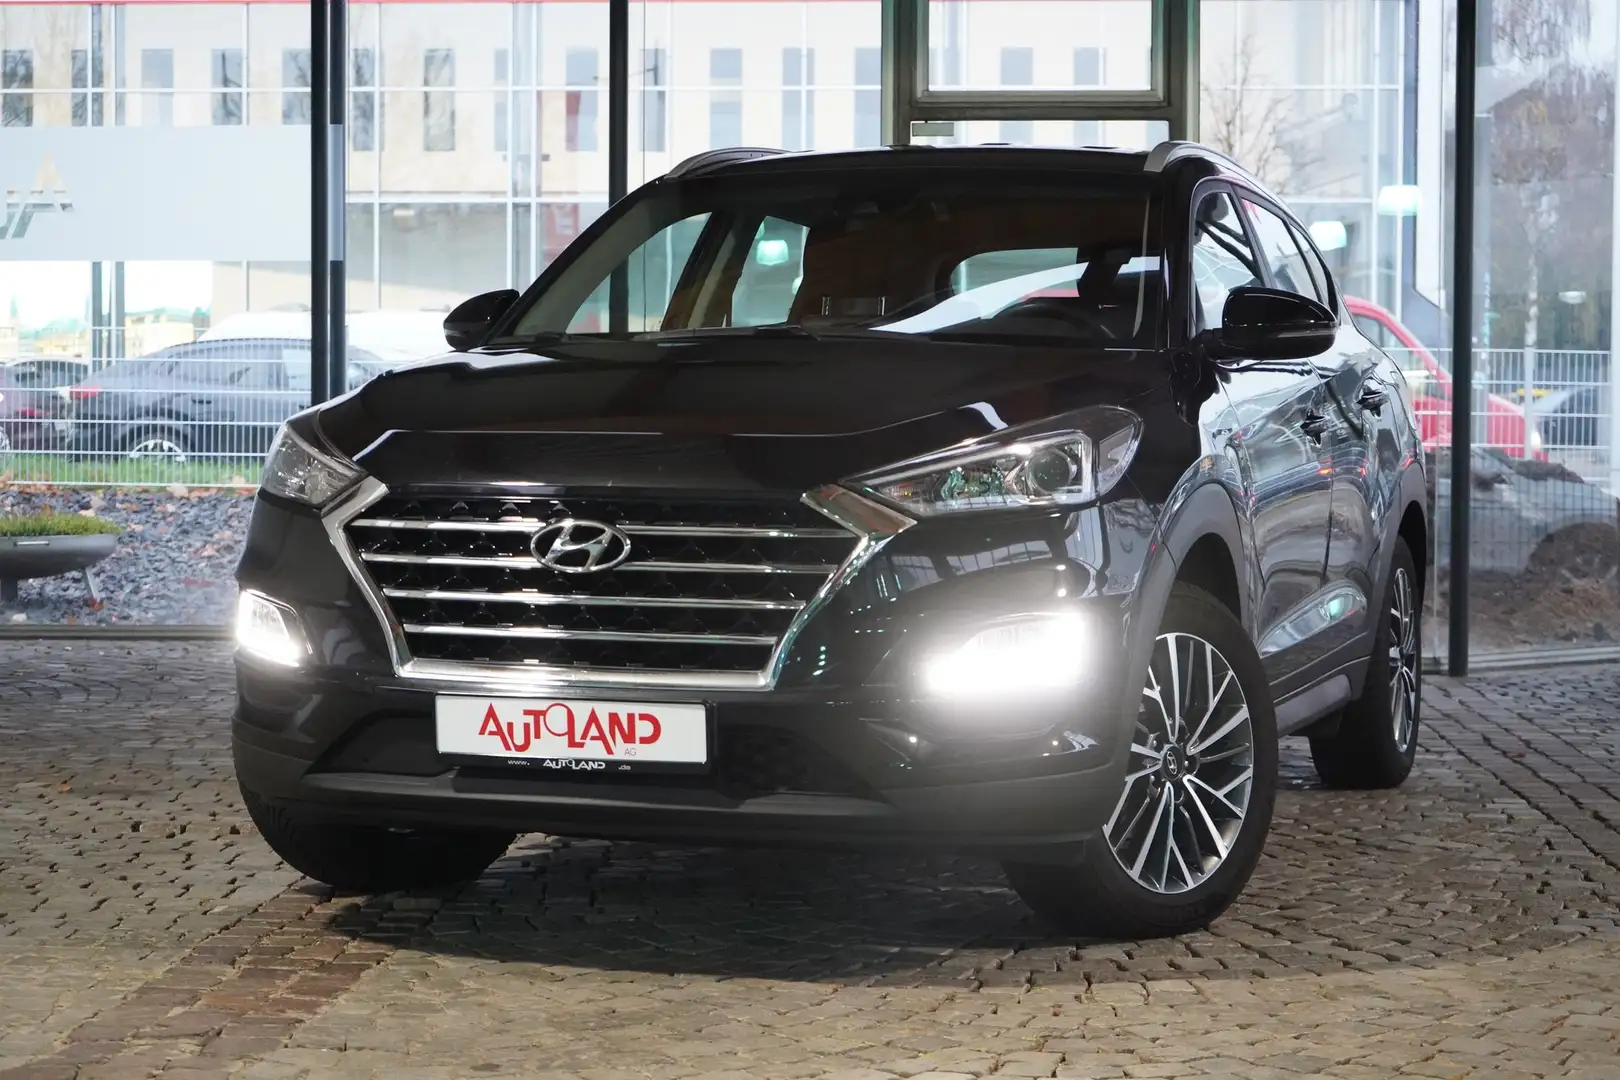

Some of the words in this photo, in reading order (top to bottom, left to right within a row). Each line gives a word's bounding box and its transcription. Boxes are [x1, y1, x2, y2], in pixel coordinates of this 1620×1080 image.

[478, 702, 662, 756] AUTOLAND
[624, 747, 637, 757] AG
[543, 758, 606, 771] AUTOLAND
